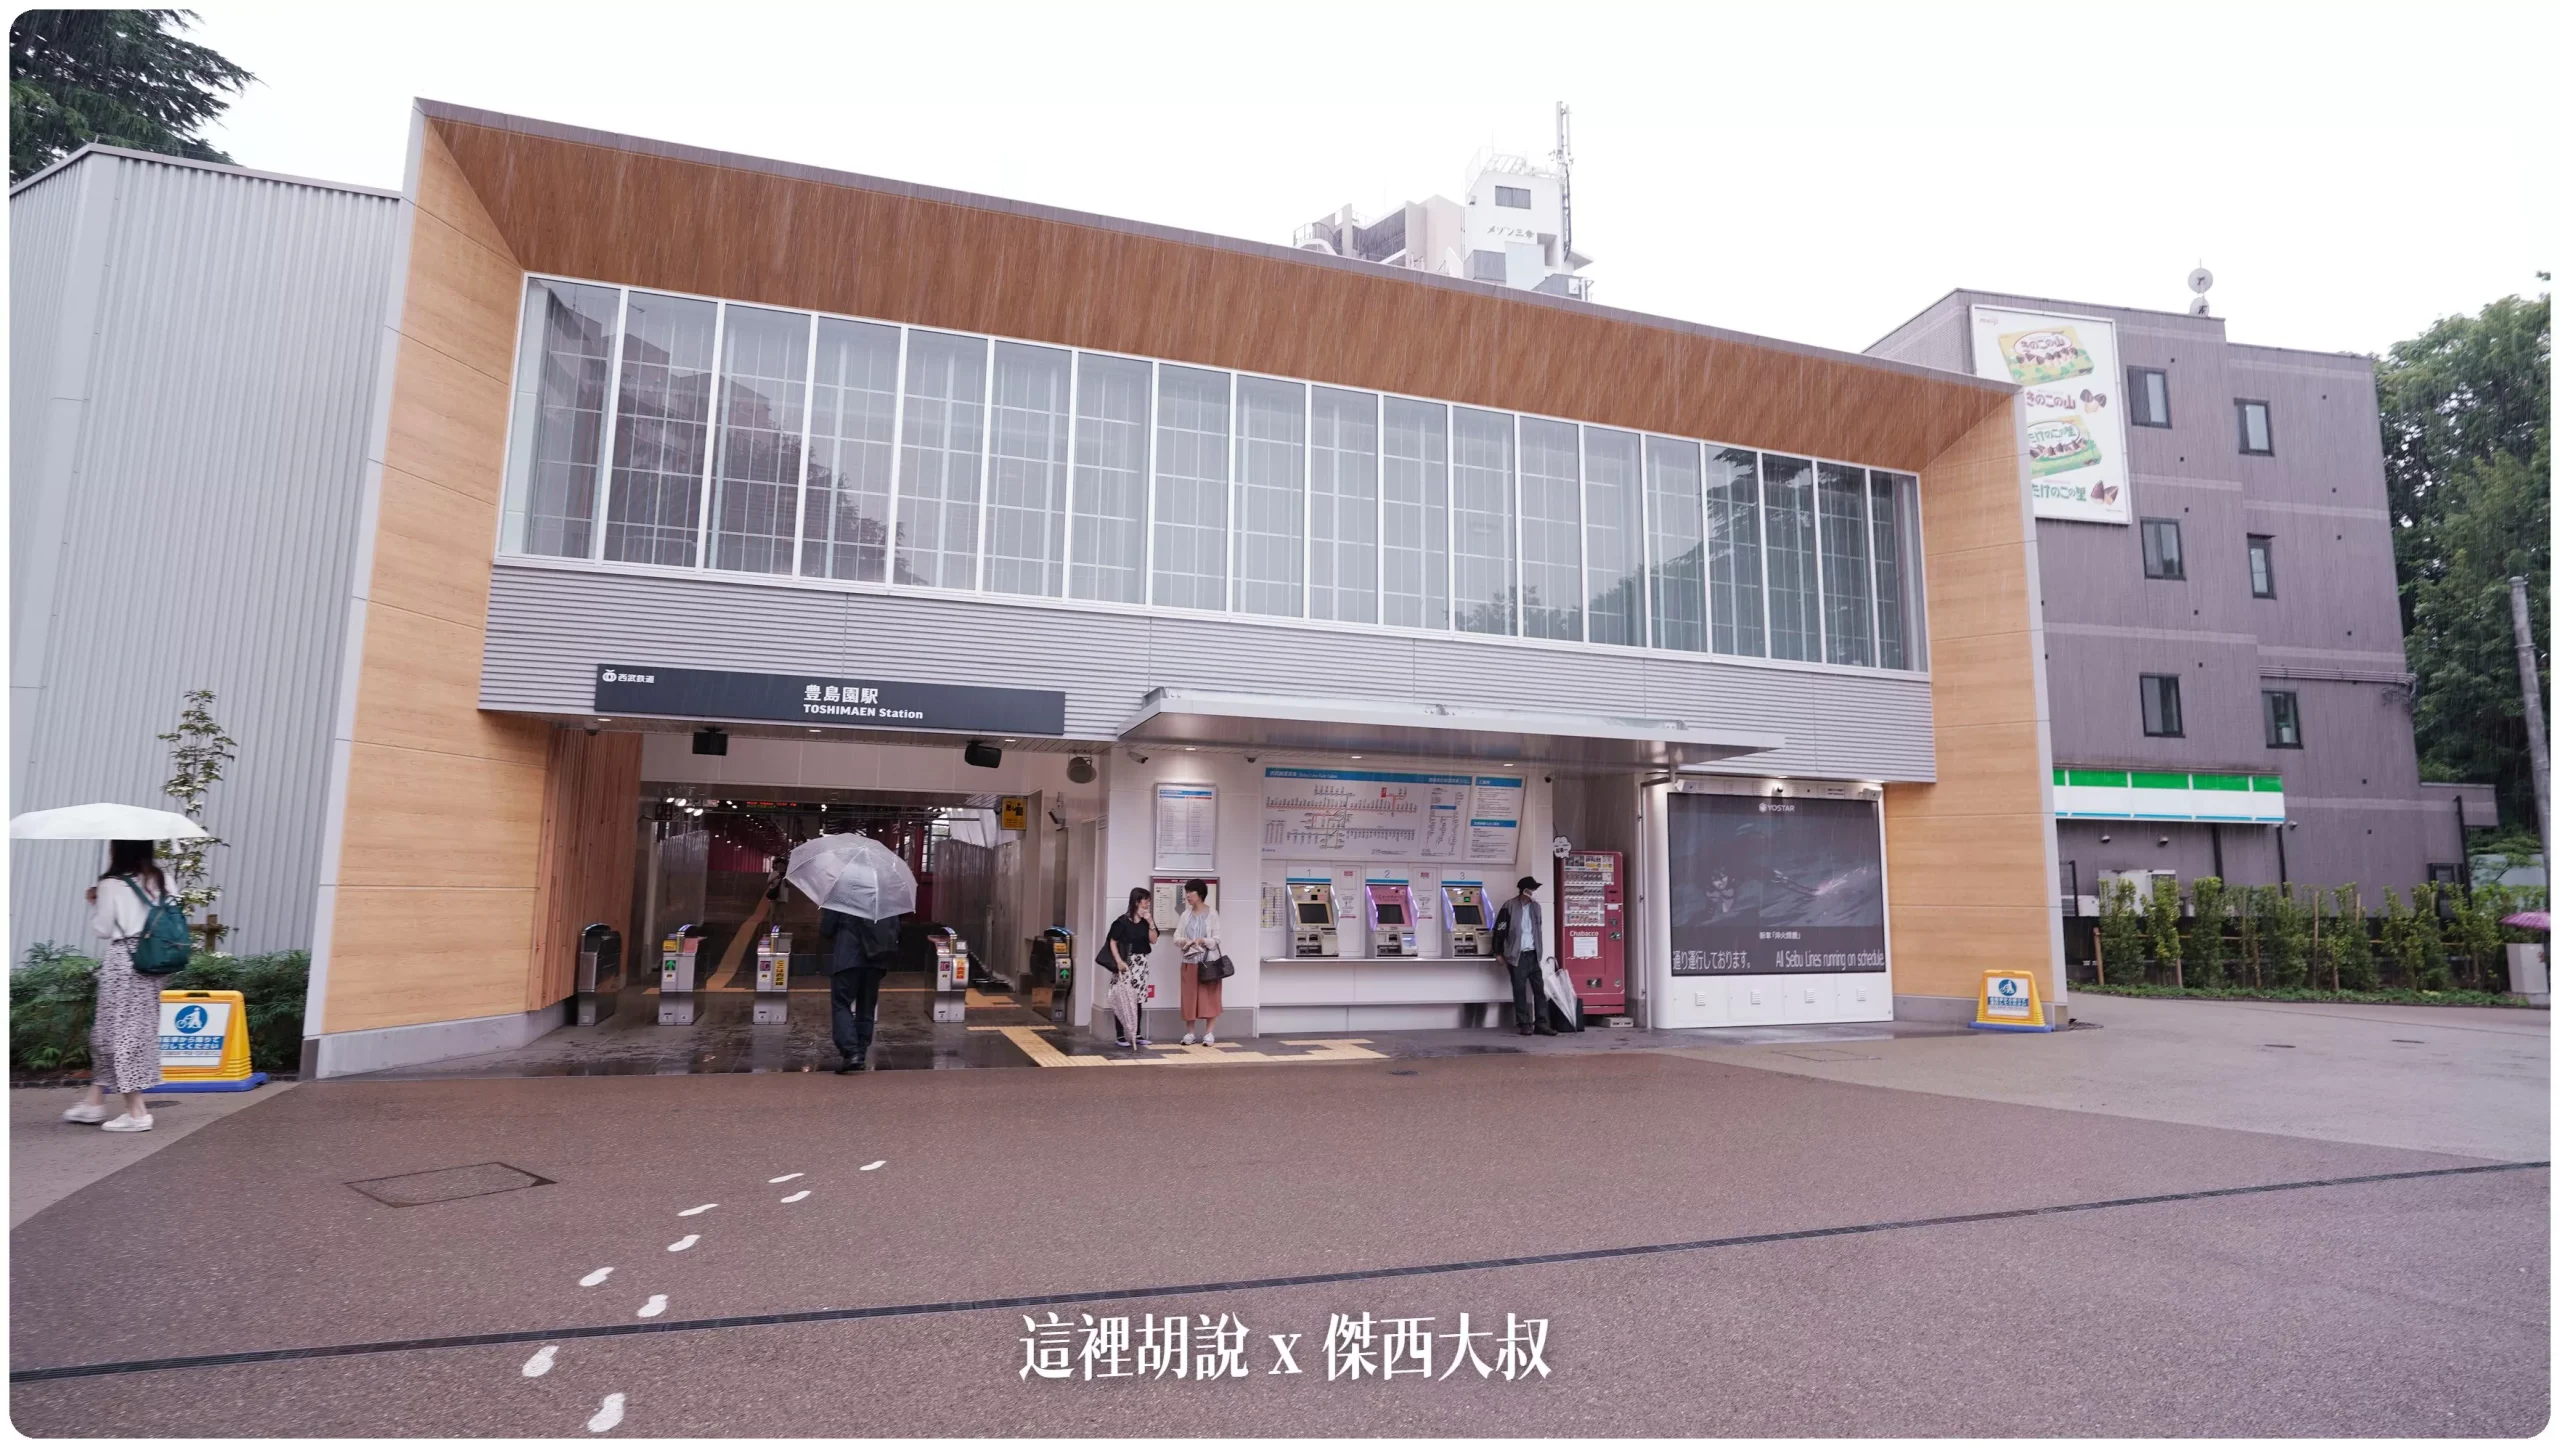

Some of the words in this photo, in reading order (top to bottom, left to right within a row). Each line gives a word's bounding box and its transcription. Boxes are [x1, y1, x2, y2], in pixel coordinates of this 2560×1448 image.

[2026, 390, 2076, 410] きのこの山
[618, 673, 655, 684] 西武鉄道
[804, 684, 878, 705] 豊島園駅
[803, 703, 876, 718] TOSHIMAEN
[878, 707, 924, 720] Station
[1767, 804, 1795, 812] YOSTAR
[1384, 870, 1390, 878] 2
[1460, 872, 1466, 880] 3
[1805, 950, 1821, 967] Lines
[1823, 949, 1846, 971] running
[1847, 953, 1856, 966] on
